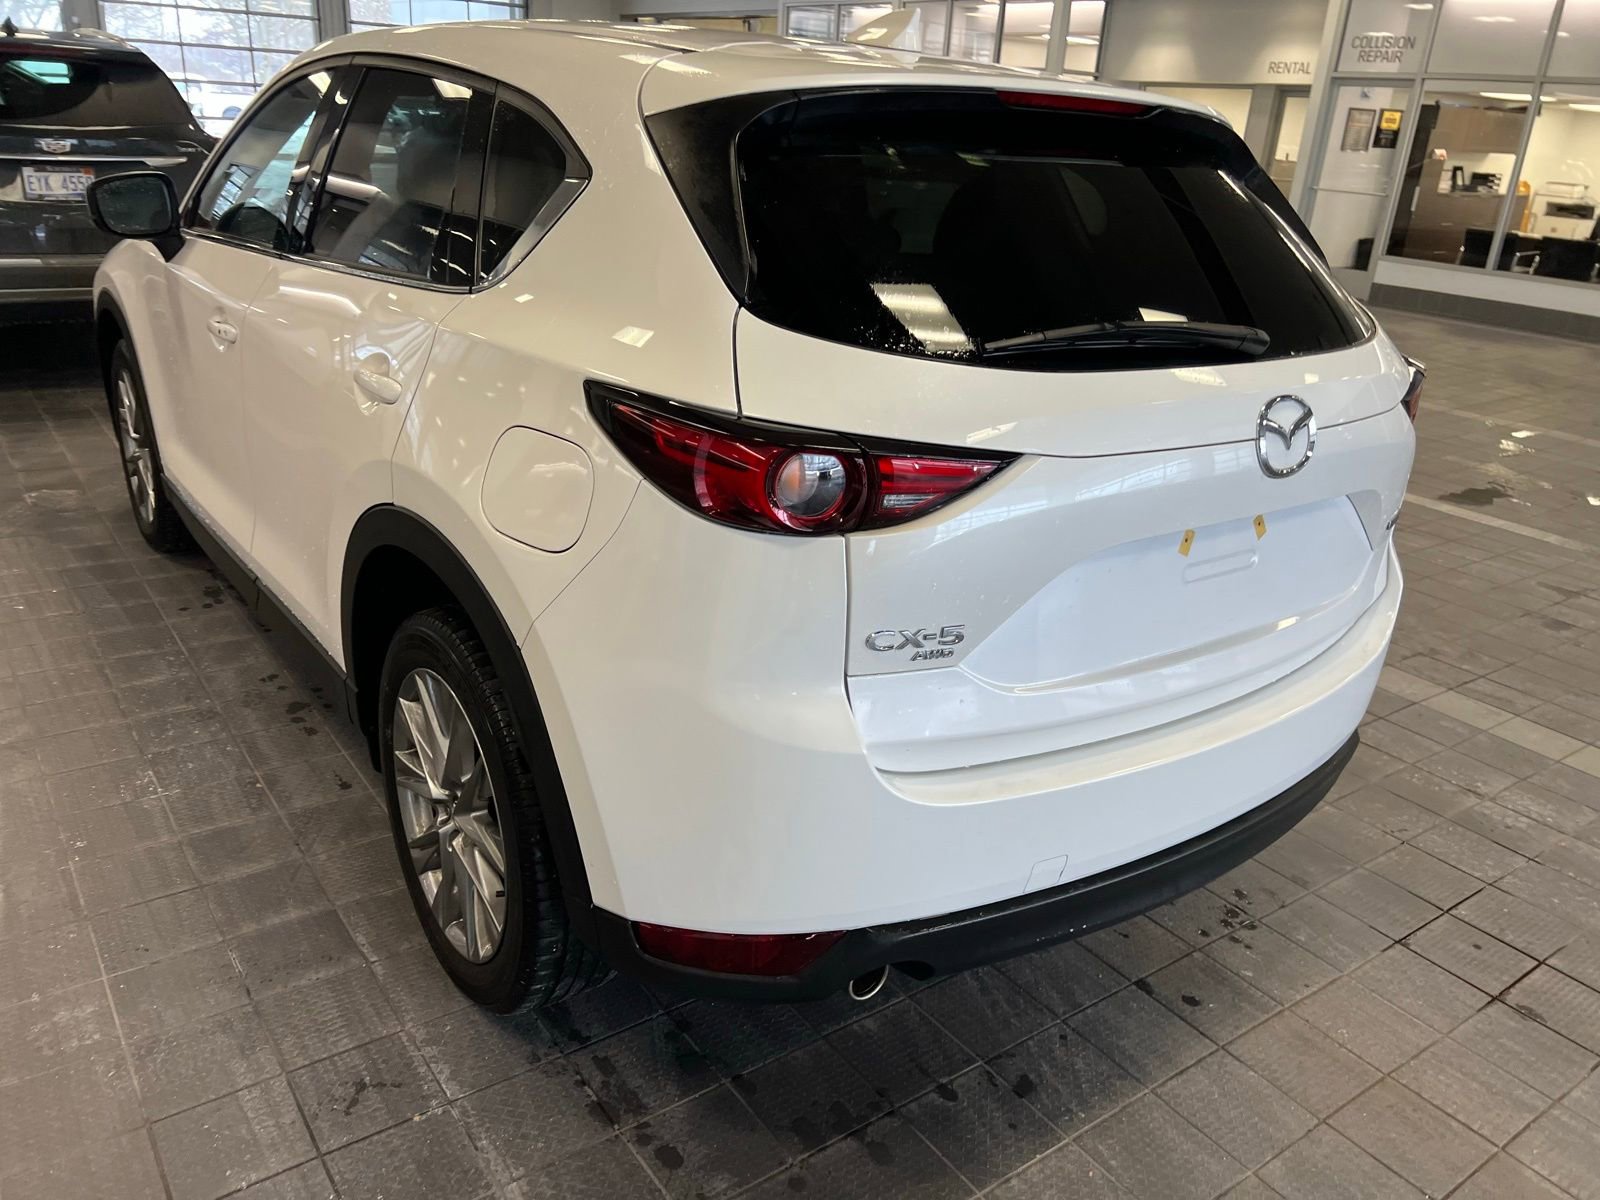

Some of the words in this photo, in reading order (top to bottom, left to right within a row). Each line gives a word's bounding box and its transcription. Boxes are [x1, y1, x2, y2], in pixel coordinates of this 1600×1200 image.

[1351, 35, 1416, 49] COLLISION
[1357, 49, 1403, 62] REPAIR
[1267, 61, 1311, 74] RENTAL
[26, 174, 54, 192] EYK
[865, 624, 965, 651] CX-5
[910, 647, 954, 661] AWD
